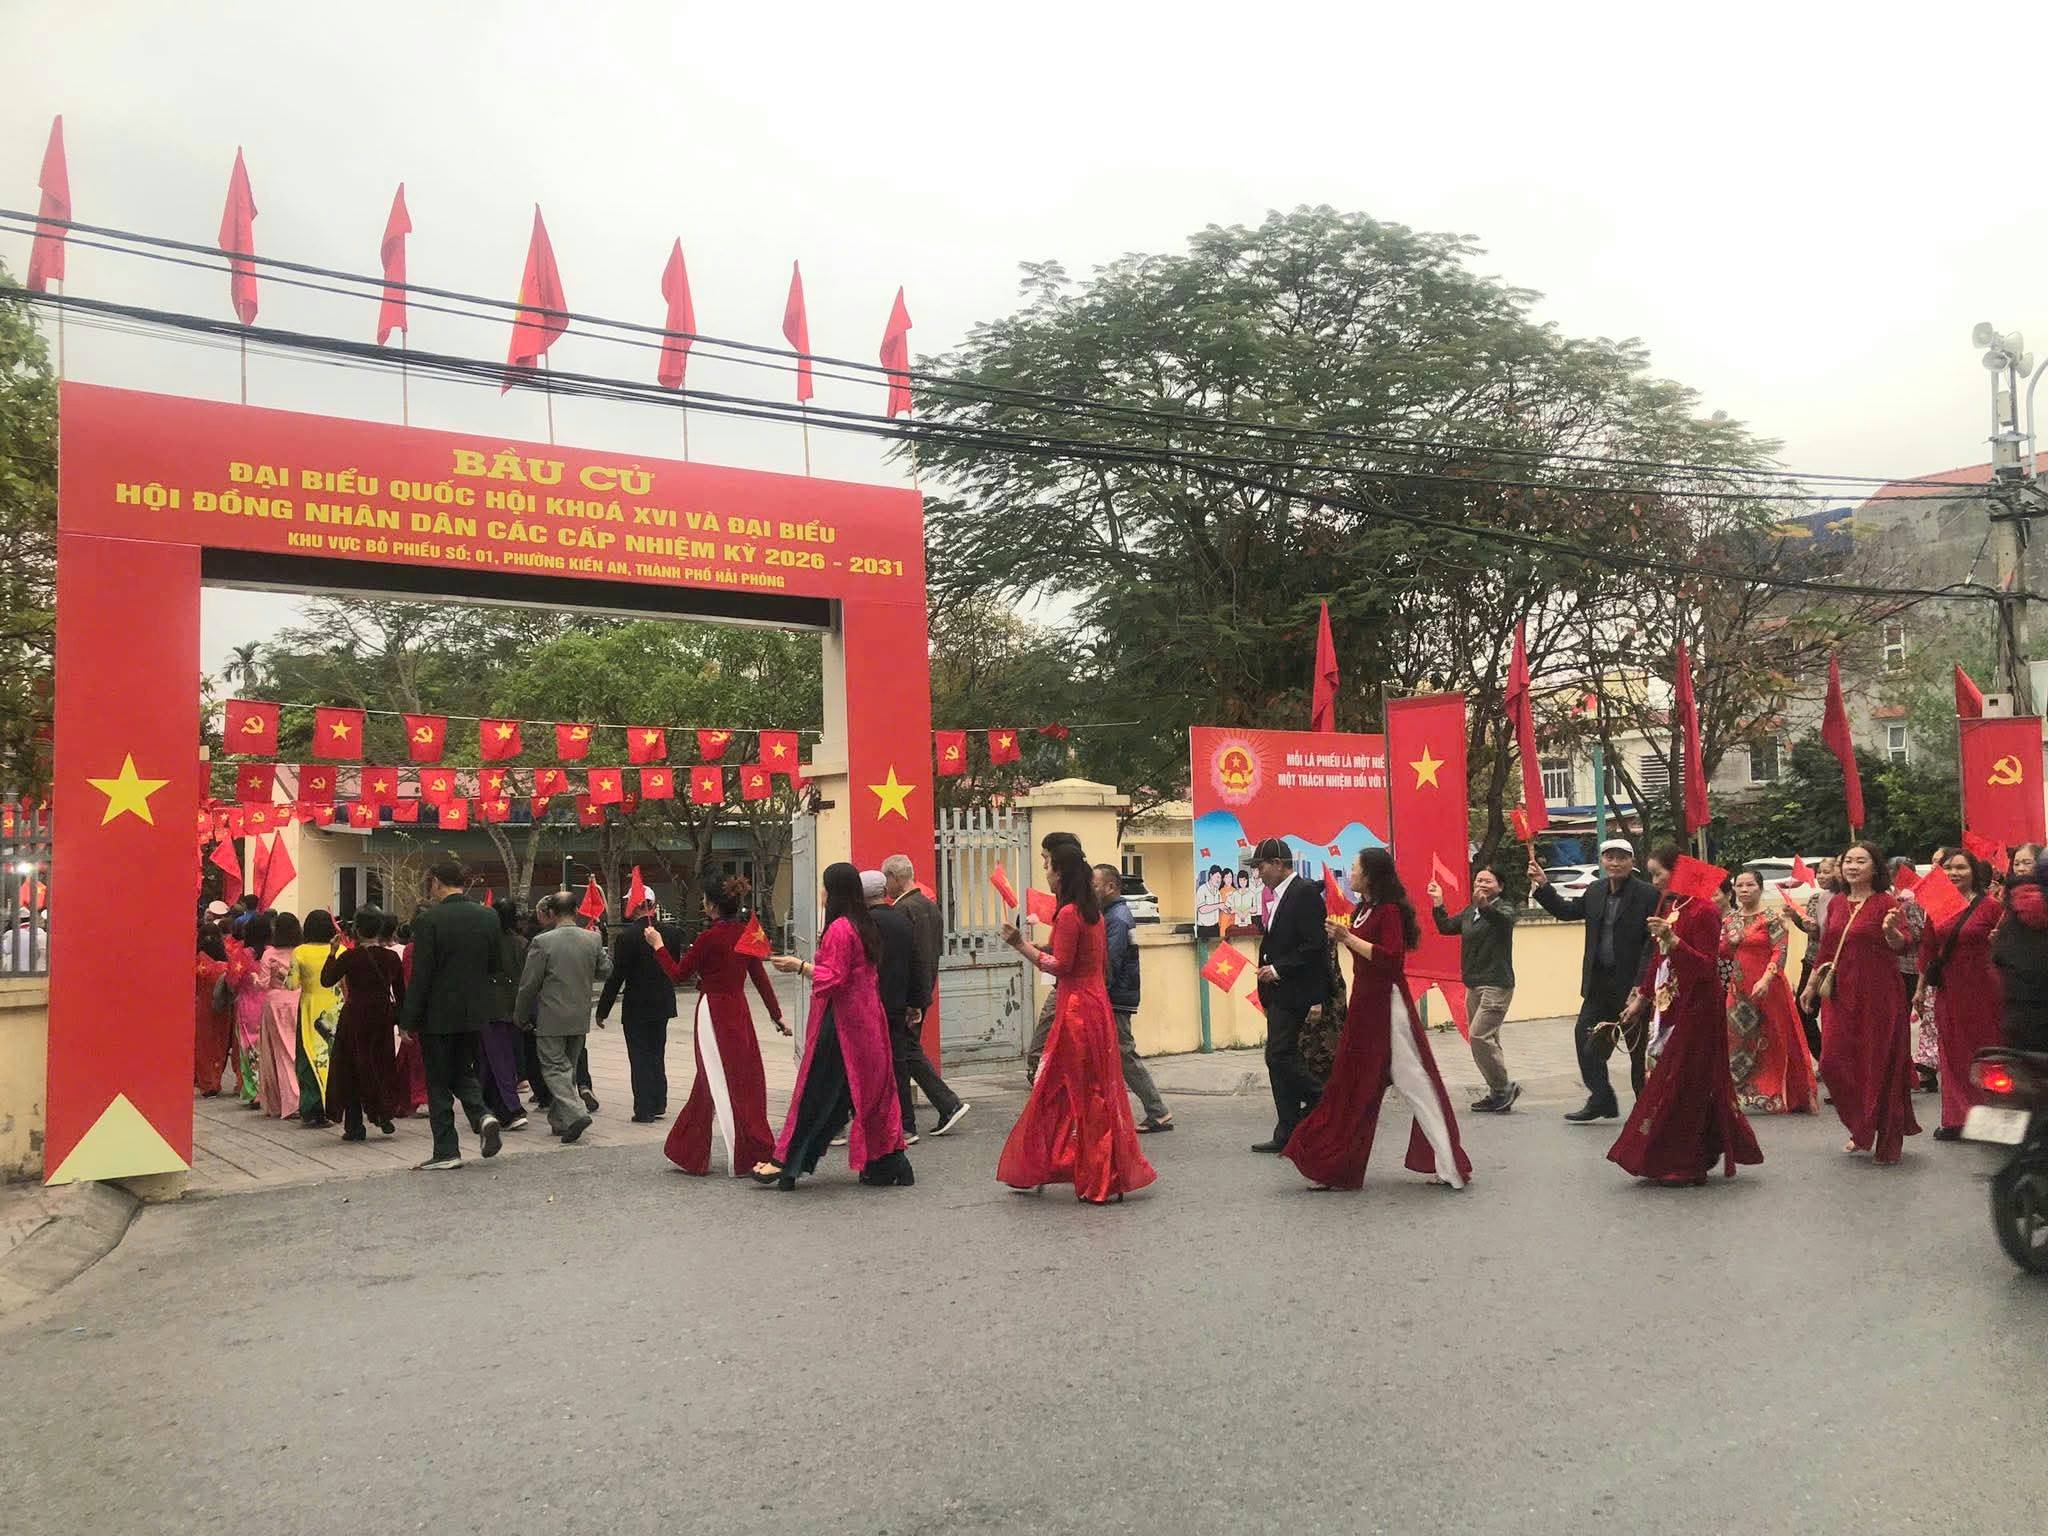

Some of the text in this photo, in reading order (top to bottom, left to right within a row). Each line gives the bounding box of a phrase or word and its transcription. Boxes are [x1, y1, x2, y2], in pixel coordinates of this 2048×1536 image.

[453, 447, 655, 495] BẦU CỬ
[229, 461, 836, 544] ĐẠI BIỂU QUỐC HỘI KHOÁ XVI VÀ ĐẠI BIỂU
[116, 482, 180, 512] HỘI
[193, 489, 293, 520] ĐỒNG
[305, 502, 400, 530] NHÂN
[411, 511, 476, 538] DÂN
[487, 519, 548, 544] CÁC
[558, 525, 615, 551] CẤP
[625, 534, 716, 561] NHIỆM
[724, 541, 756, 563] KỲ
[765, 549, 825, 570] 2026
[849, 556, 904, 577] 2031
[288, 532, 785, 588] KHU VỰC BỎ PHIẾU SỐ: 01, PHƯỜNG KIẾN AN, THÀNH PHỐ HẢI PHÒNG
[1278, 772, 1296, 788] MỘT
[1298, 772, 1324, 787] TRÁCH
[1326, 773, 1352, 790] NHIỆM
[1316, 752, 1340, 768] PHIẾU
